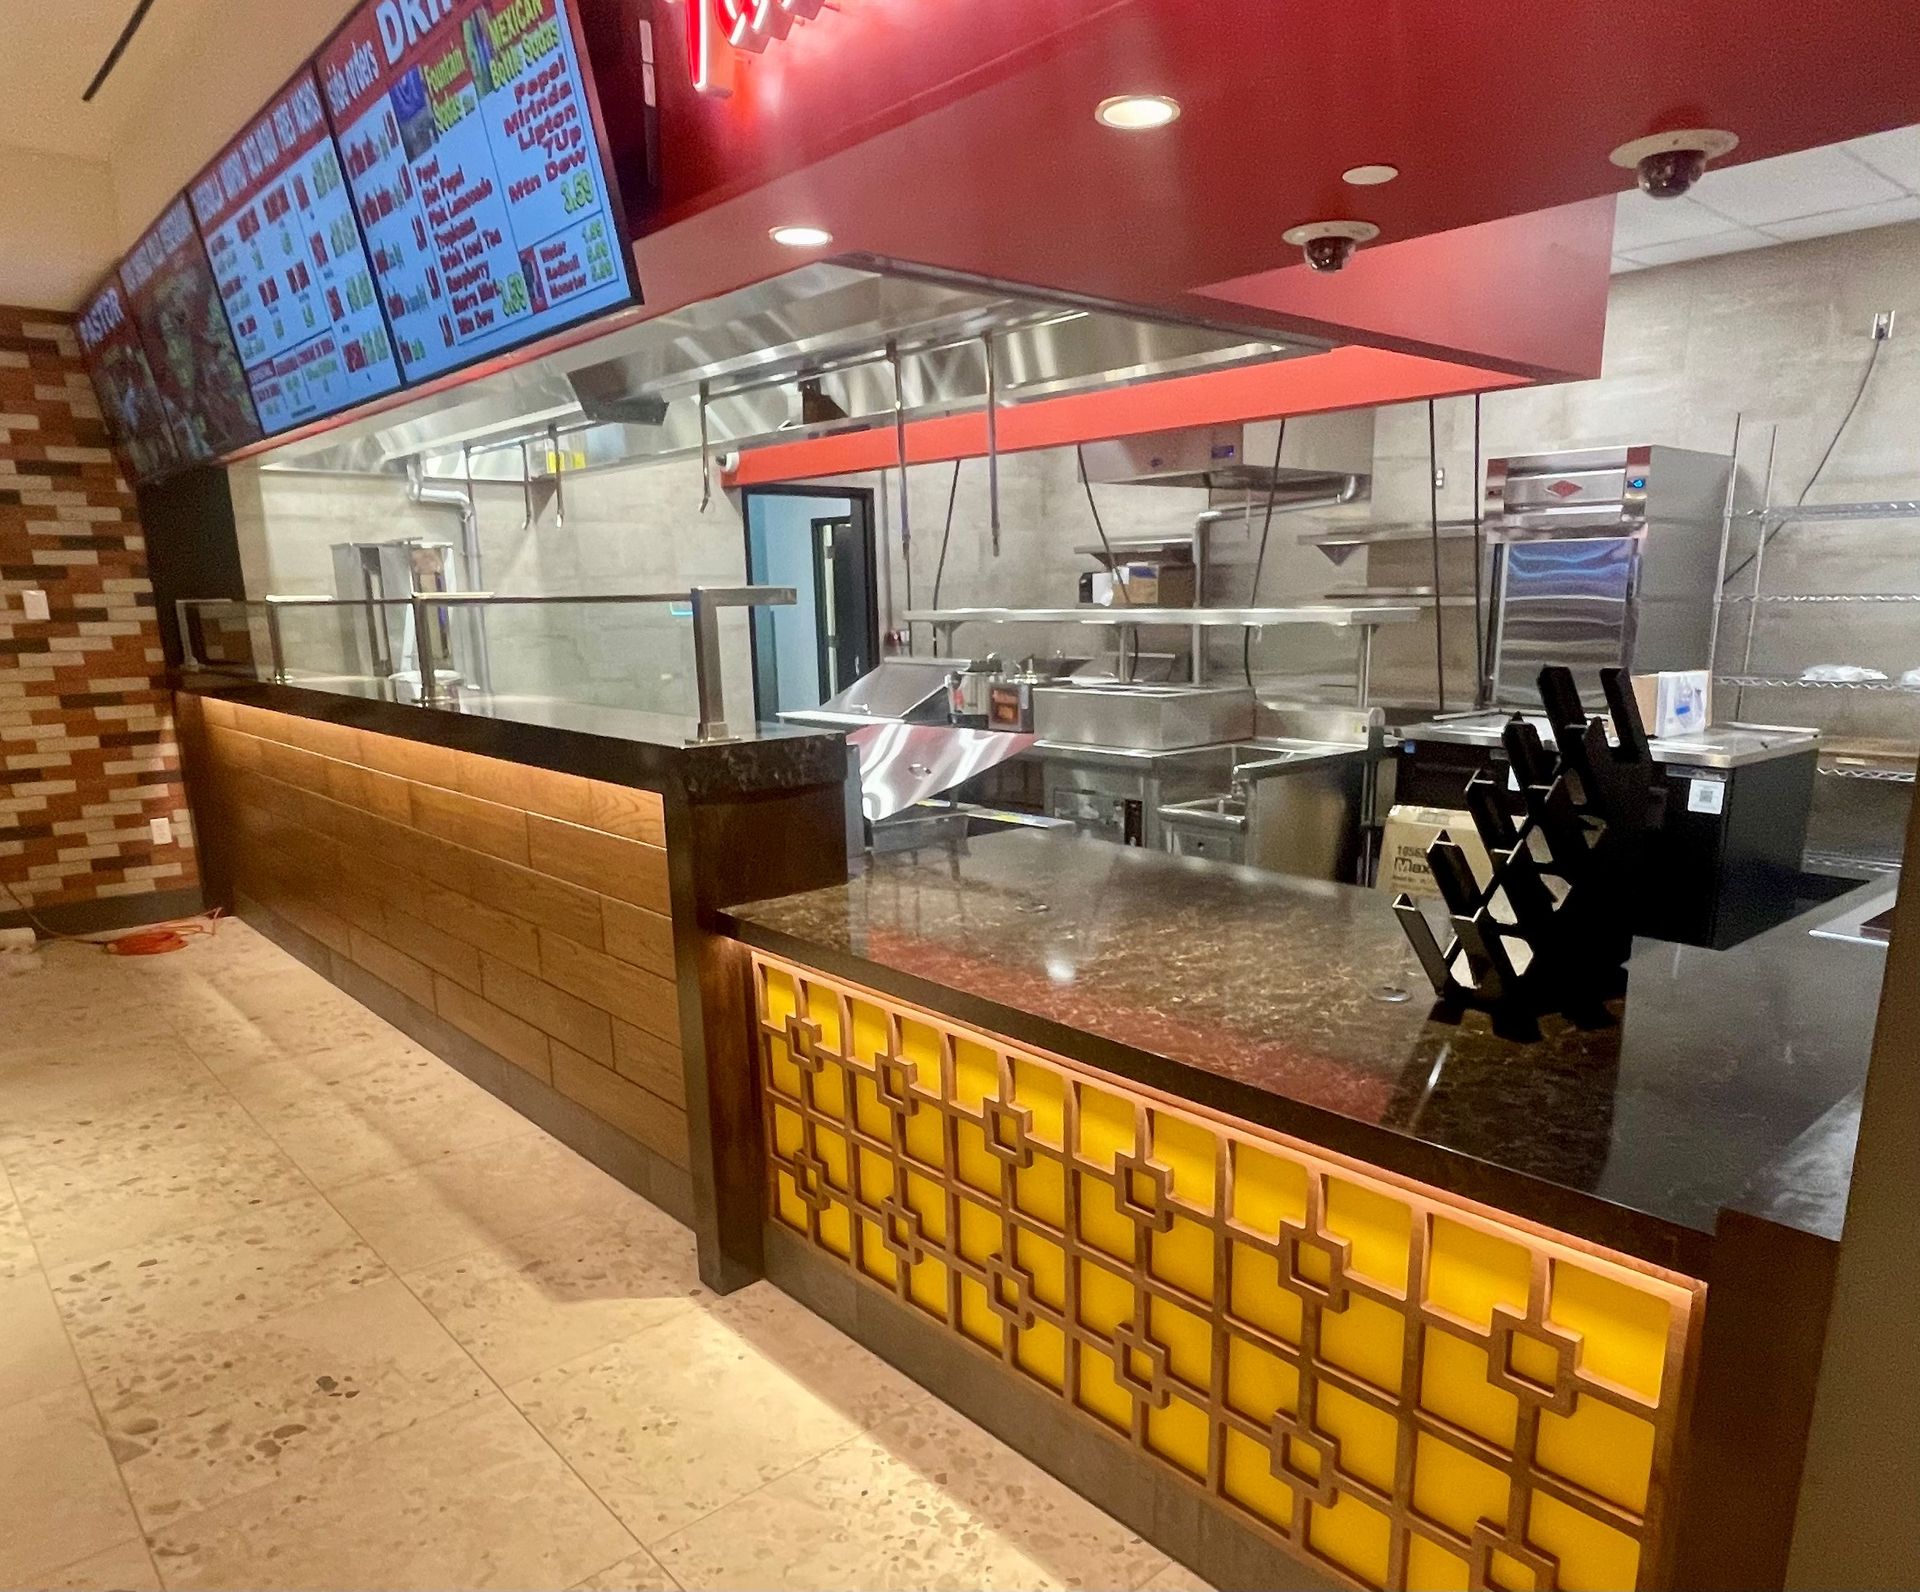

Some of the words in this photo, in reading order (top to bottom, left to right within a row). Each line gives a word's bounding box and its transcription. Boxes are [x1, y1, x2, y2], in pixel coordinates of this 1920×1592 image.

[326, 62, 350, 118] side
[345, 40, 379, 100] orders
[423, 41, 466, 99] Fountain
[490, 44, 523, 92] Bottle
[521, 22, 559, 66] Sodas
[514, 52, 566, 105] Pepsi
[503, 80, 572, 138] Mirinda
[517, 103, 577, 152] Lipton
[416, 153, 440, 187] Pepsi
[440, 163, 465, 196] Pepsi
[446, 177, 493, 218] Lemonade
[508, 174, 542, 204] Mtn
[544, 146, 586, 182] Dew
[446, 260, 490, 295] Raspberry
[79, 286, 125, 353] PASTOR
